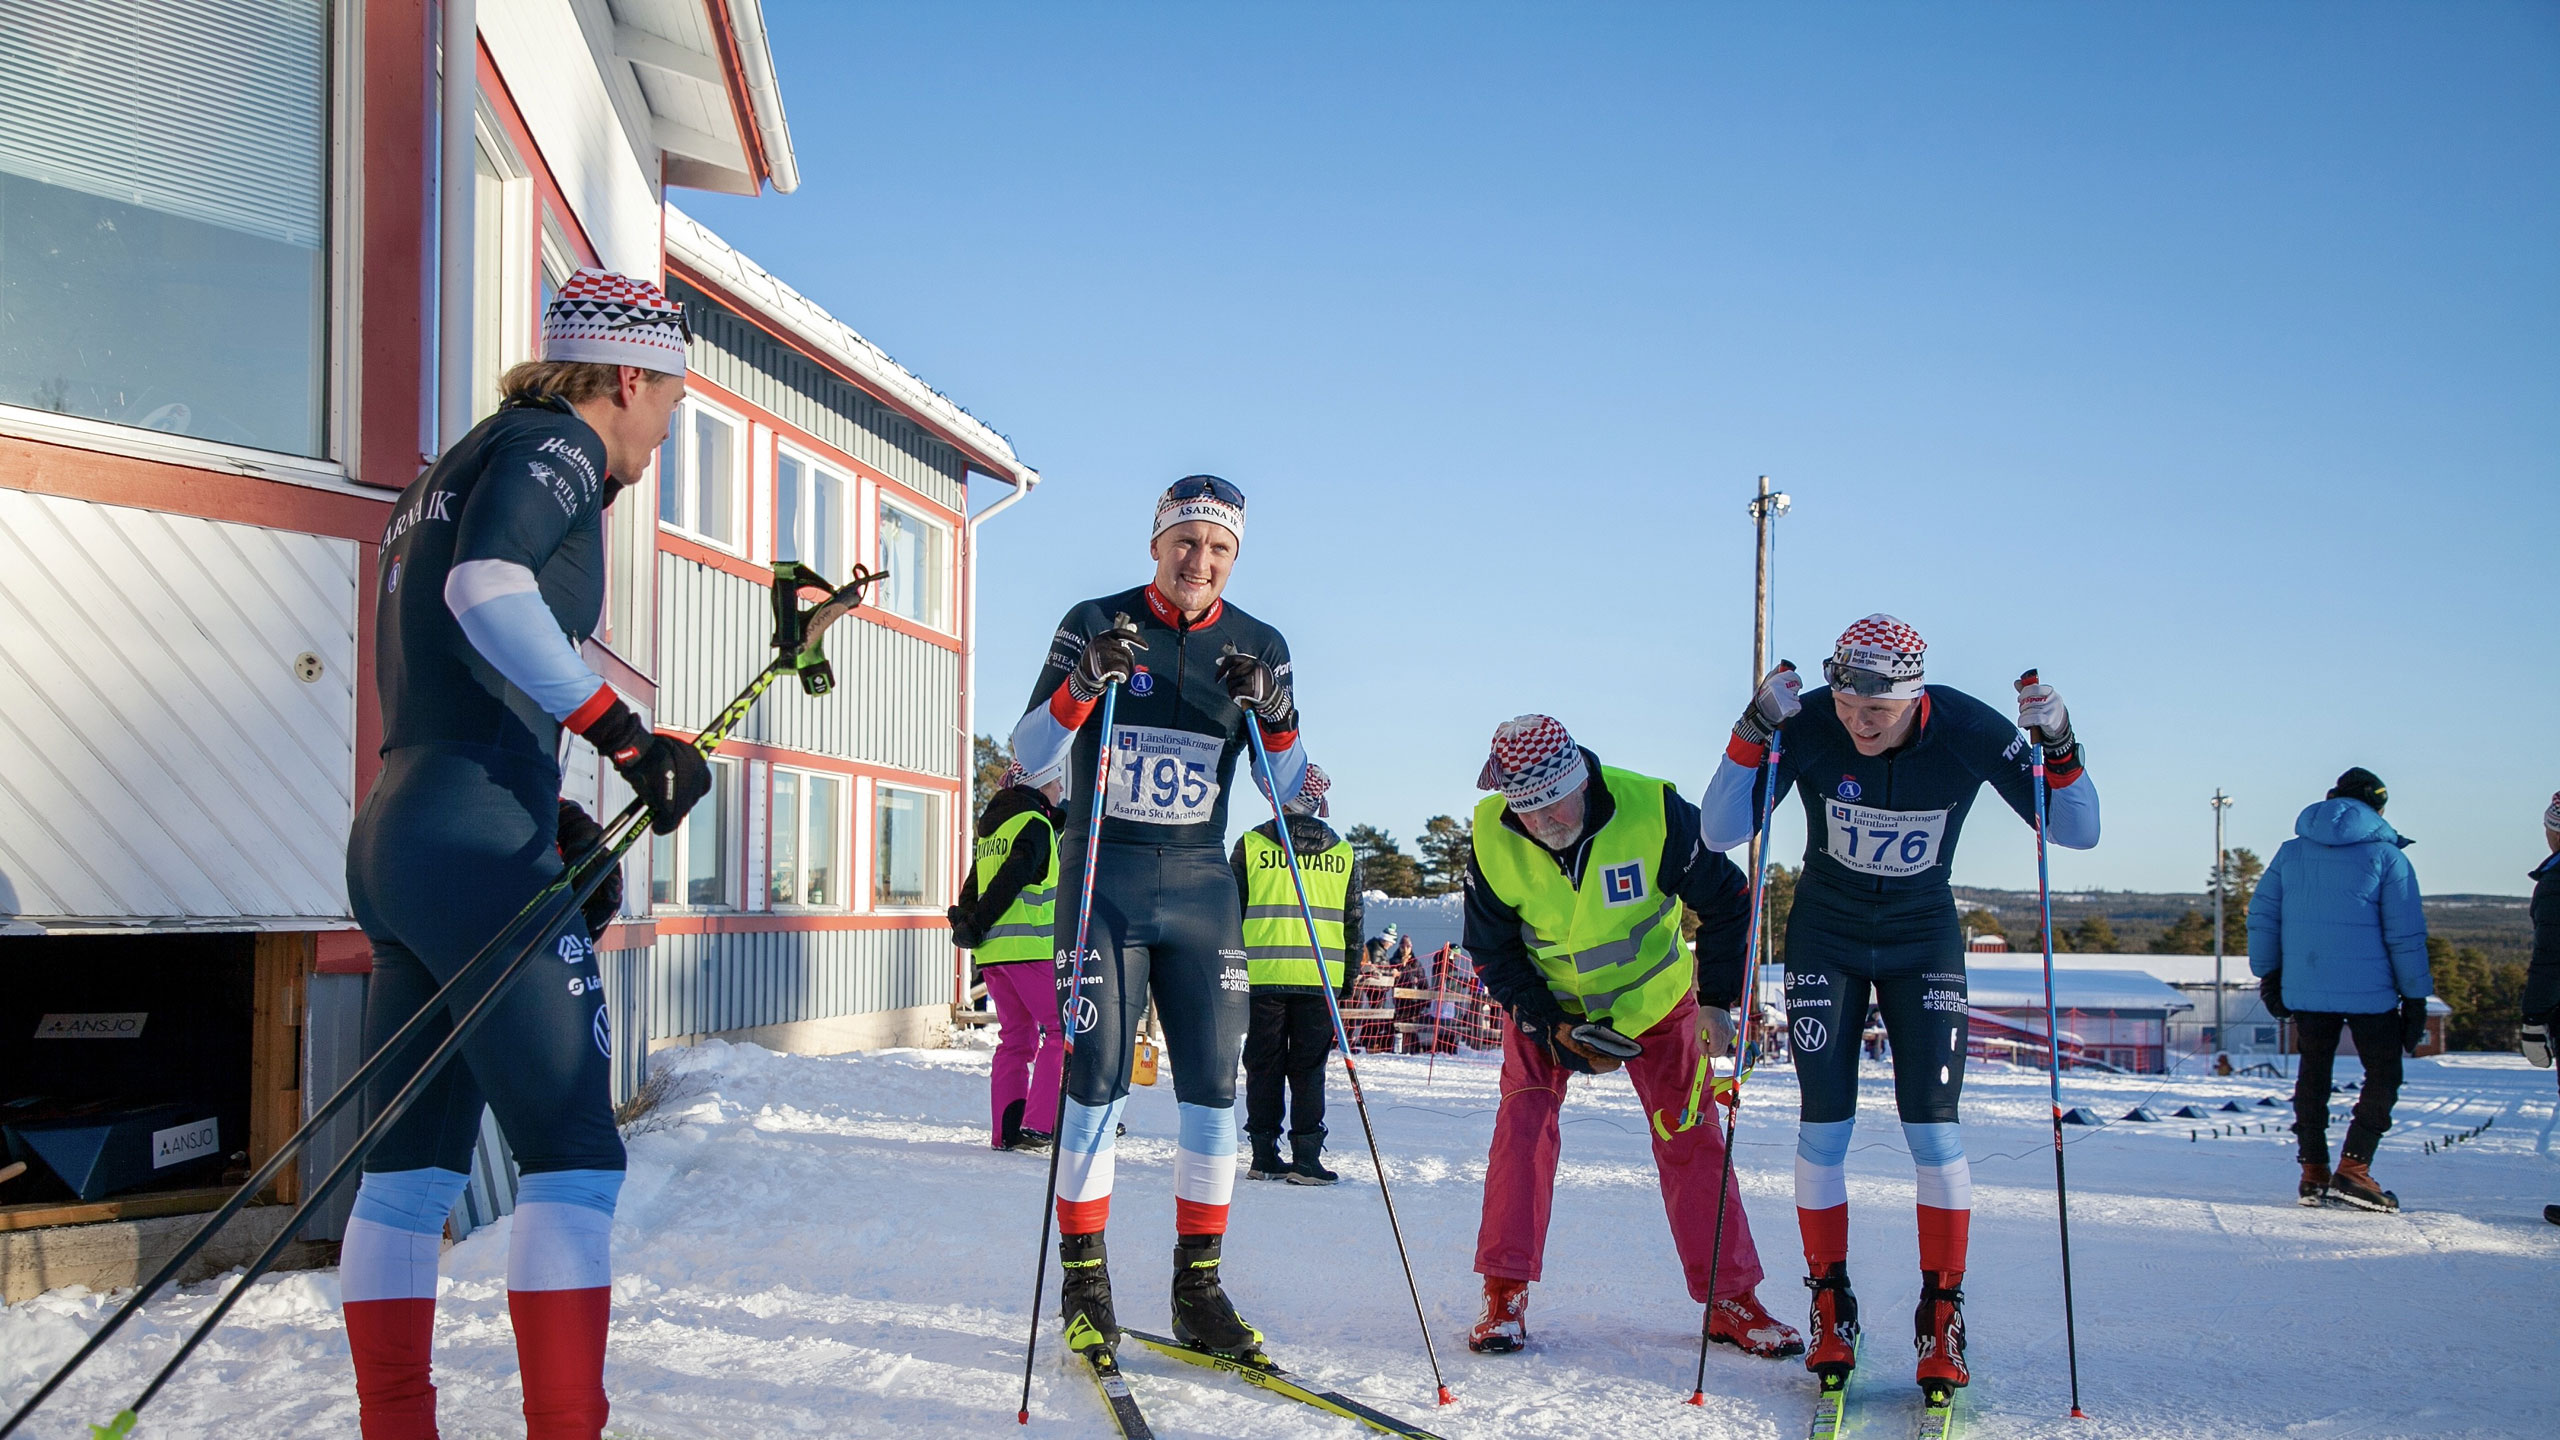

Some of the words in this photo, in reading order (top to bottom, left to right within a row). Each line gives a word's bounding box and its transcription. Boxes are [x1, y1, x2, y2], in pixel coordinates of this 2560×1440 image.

[537, 437, 598, 493] Hedmans
[1178, 505, 1228, 521] ÅSARNA
[378, 496, 423, 560] ARNA
[426, 490, 457, 522] IK
[1139, 743, 1182, 756] Jämtland
[1140, 732, 1220, 752] Länsförsäkringar
[1125, 755, 1209, 809] 195
[1510, 796, 1544, 809] ARNA
[1545, 785, 1560, 799] IK
[1113, 801, 1146, 817] Åsarna
[1148, 808, 1164, 819] Ski
[1854, 809, 1942, 823] Länsförsäkringar
[1853, 817, 1899, 829] Jämtland
[1840, 825, 1930, 865] 176
[1834, 848, 1864, 869] Åsarna
[1866, 862, 1881, 871] Ski
[1883, 859, 1930, 873] Marathon
[1062, 974, 1104, 988] Länen
[1797, 974, 1829, 986] SCA
[1792, 998, 1832, 1009] Lännen
[1927, 988, 1961, 1002] ÅSARNA
[1718, 1299, 1755, 1321] pina
